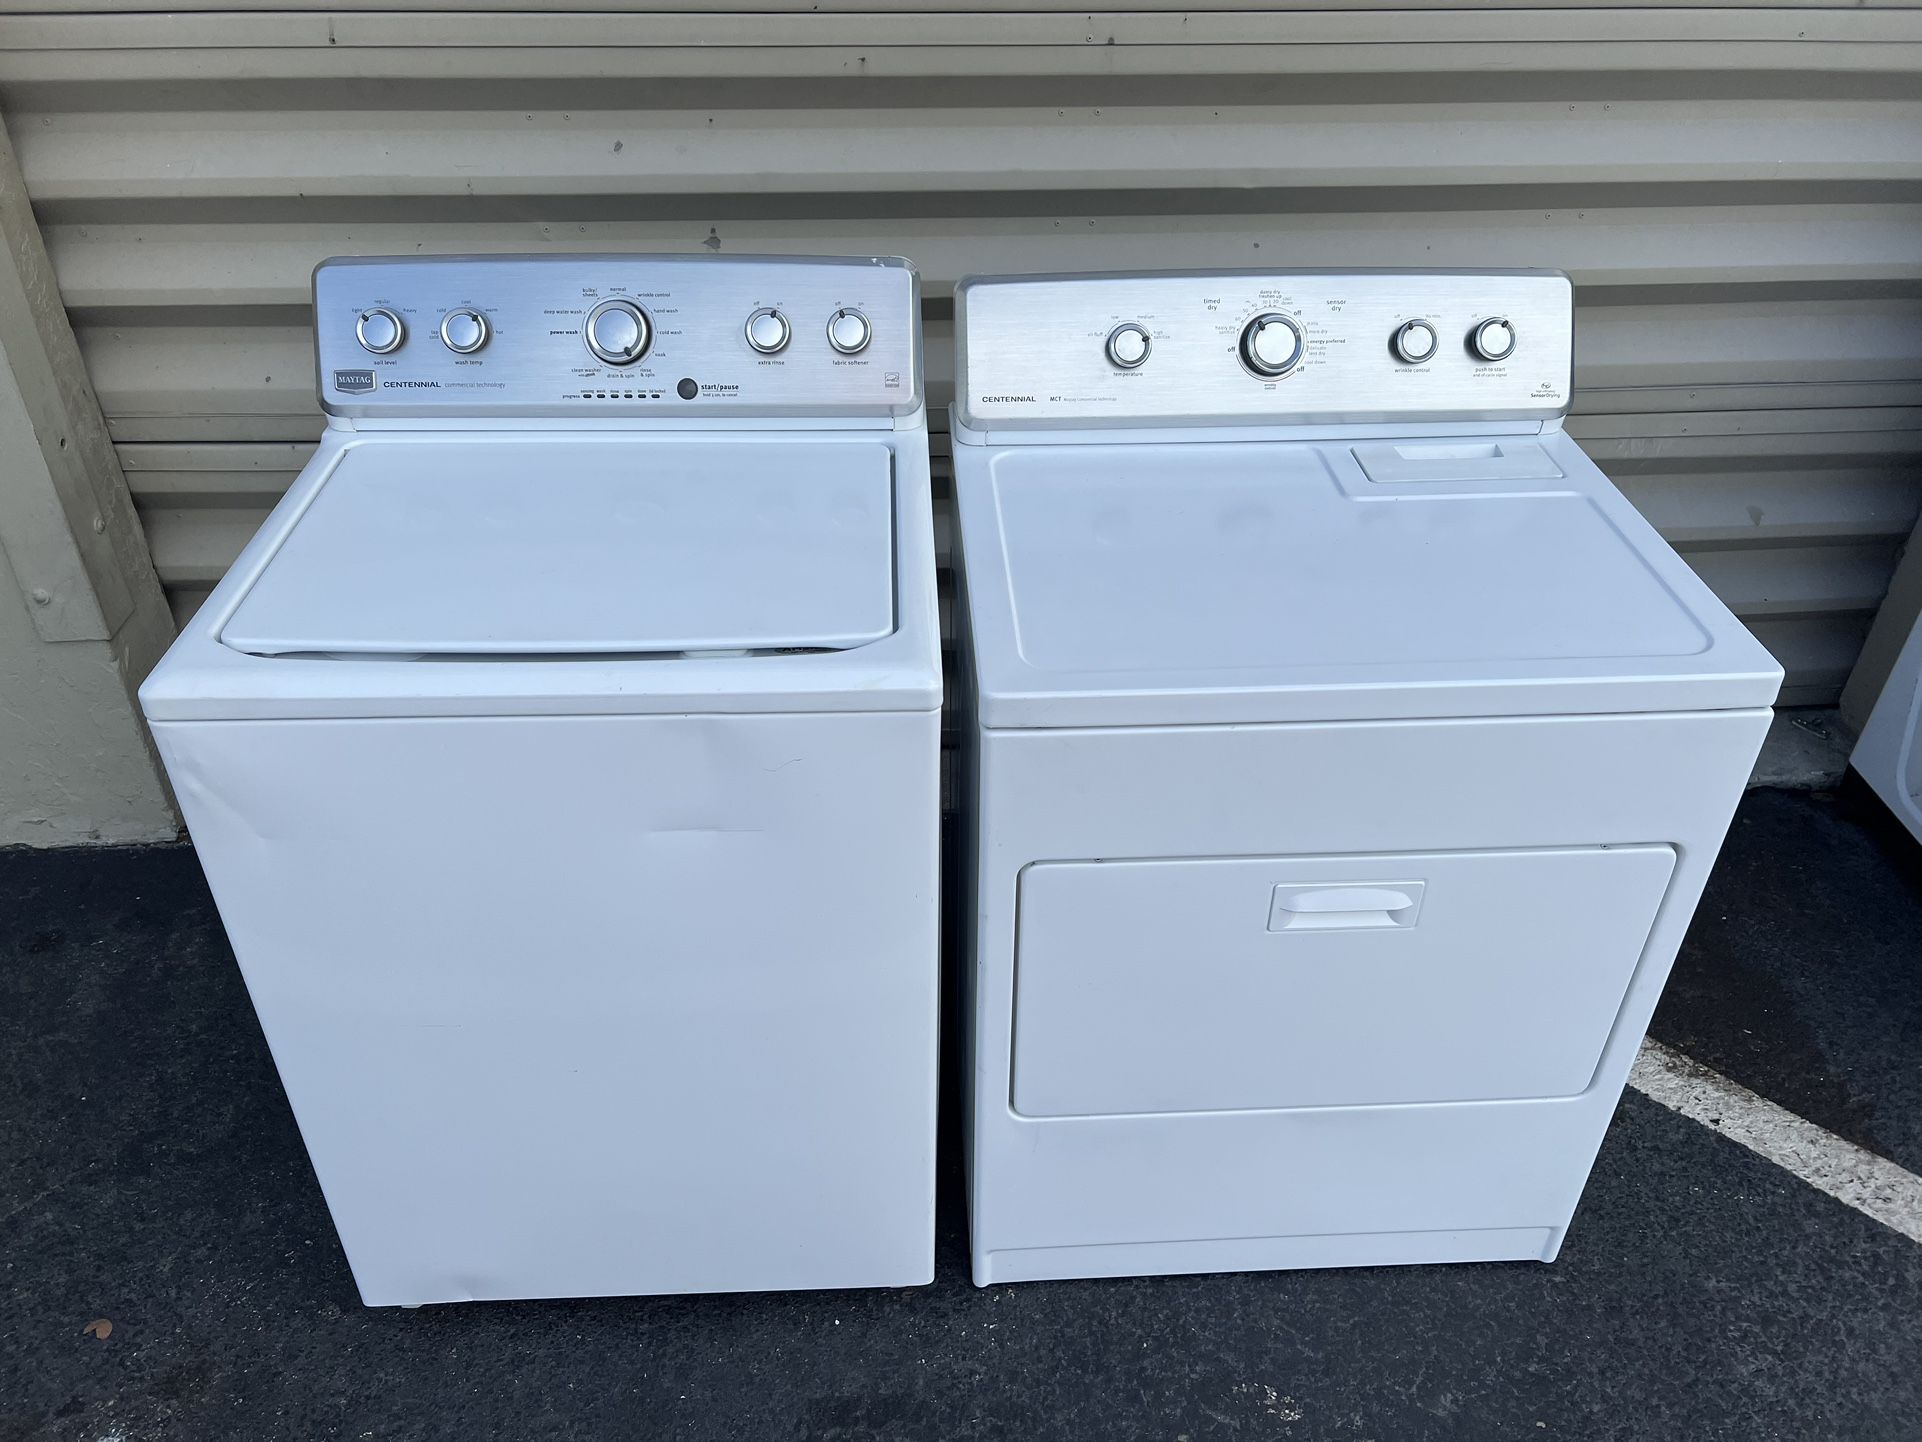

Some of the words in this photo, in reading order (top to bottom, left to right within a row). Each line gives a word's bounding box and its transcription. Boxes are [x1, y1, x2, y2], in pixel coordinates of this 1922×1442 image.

[338, 375, 371, 385] MAYTAG
[476, 380, 505, 389] technology
[701, 383, 739, 392] start/pause
